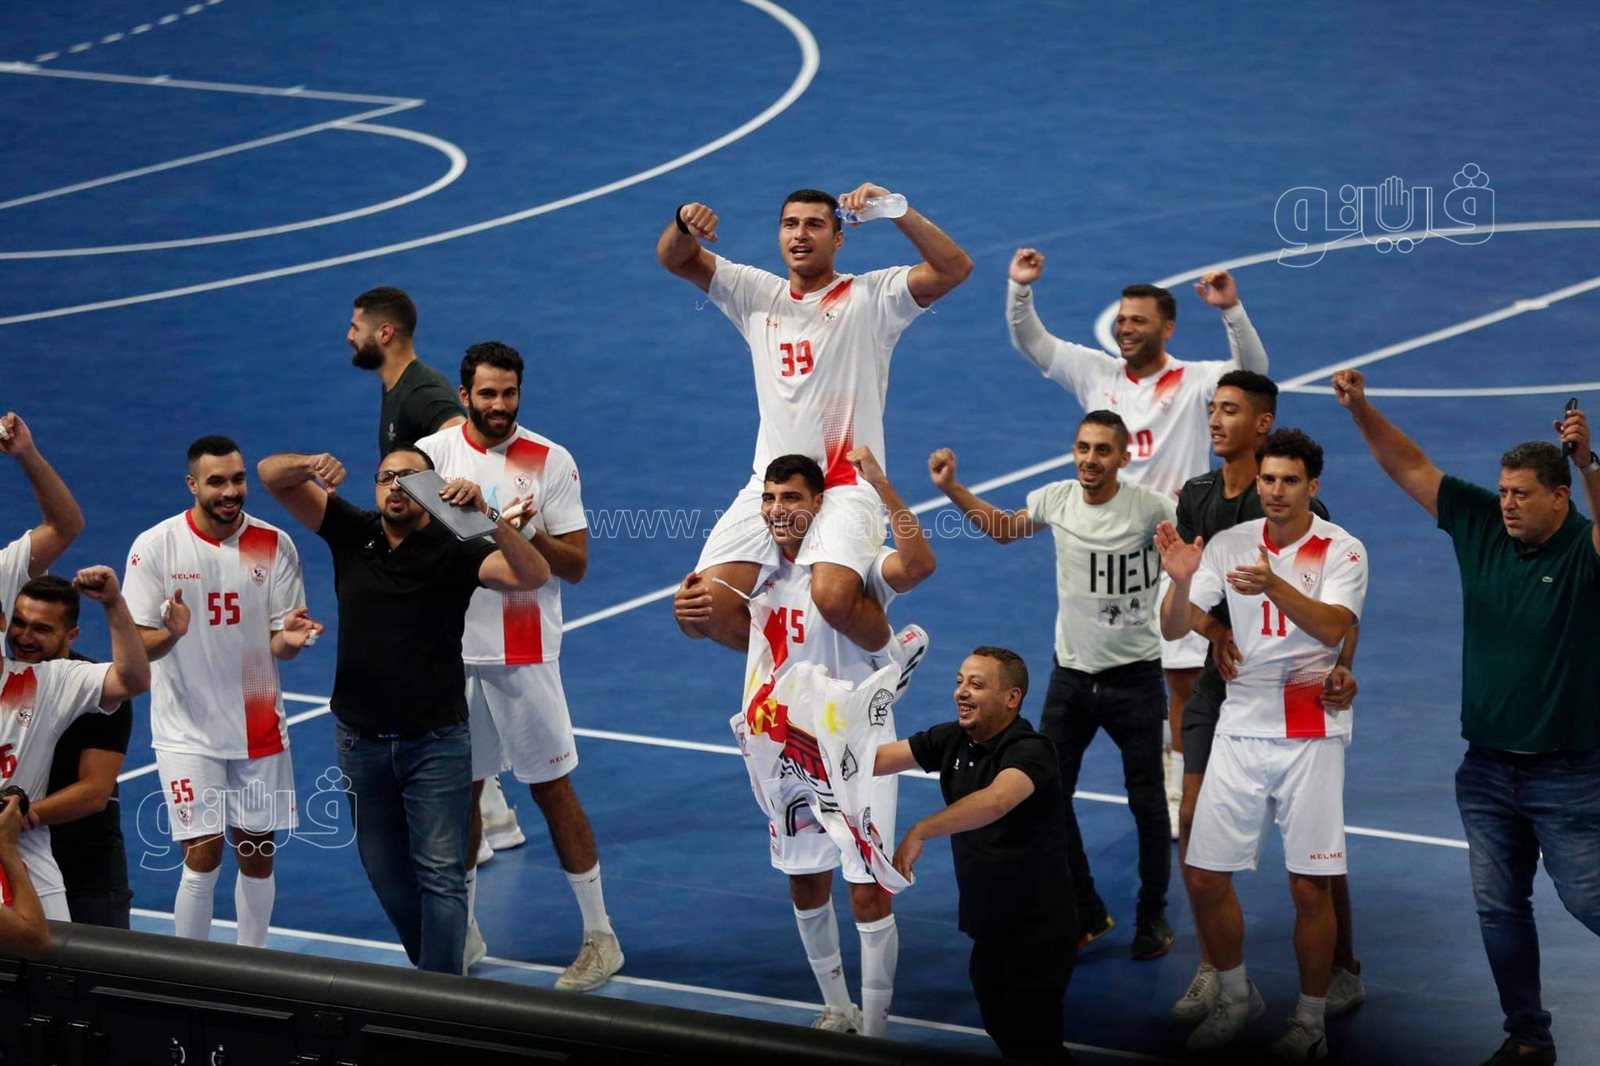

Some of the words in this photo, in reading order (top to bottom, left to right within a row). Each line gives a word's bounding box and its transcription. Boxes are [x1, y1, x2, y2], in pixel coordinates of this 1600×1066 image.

[779, 340, 815, 378] 39
[1126, 429, 1154, 458] 0
[207, 591, 241, 626] 55
[774, 606, 805, 644] 45
[1261, 600, 1288, 637] 11
[169, 778, 195, 804] 55
[1309, 852, 1343, 860] KELME
